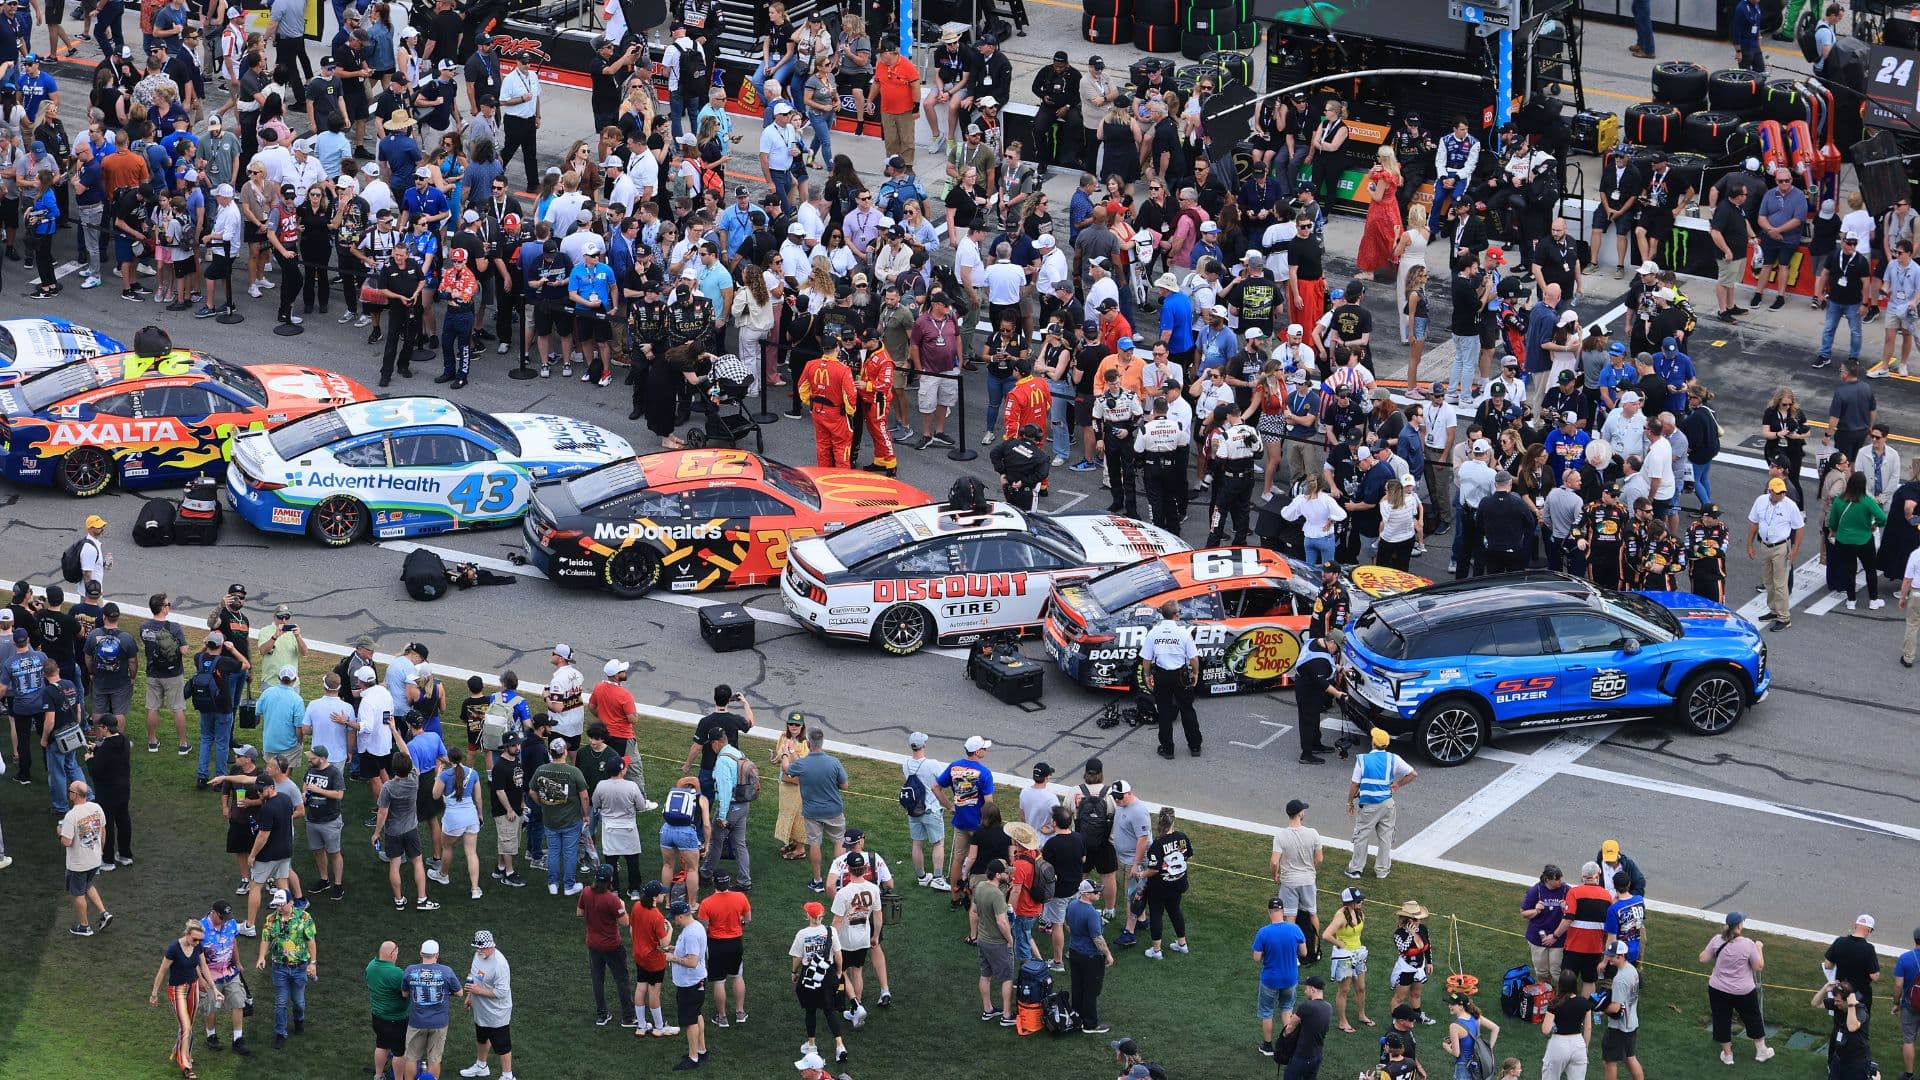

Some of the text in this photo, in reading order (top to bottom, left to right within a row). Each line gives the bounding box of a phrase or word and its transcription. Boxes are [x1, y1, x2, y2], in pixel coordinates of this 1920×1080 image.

[1485, 15, 1509, 25] musco
[1875, 56, 1914, 87] 24
[1352, 152, 1380, 161] LEGAC
[50, 421, 179, 446] AXALTA
[676, 451, 749, 479] 23
[447, 470, 520, 516] 43
[273, 508, 302, 518] FAMILY
[594, 522, 722, 541] McDonald's
[568, 557, 594, 567] leidos
[1192, 549, 1268, 582] 19
[565, 568, 596, 577] Columbia
[873, 572, 1028, 603] DISCOUNT
[947, 602, 994, 616] TIRE
[810, 612, 817, 621] 2
[1154, 638, 1181, 646] OFFICIAL
[1254, 631, 1284, 646] Bass
[1089, 648, 1138, 660] BOATS
[1254, 645, 1278, 659] Pro
[1254, 657, 1291, 673] Shops
[1202, 673, 1226, 681] COFFEE
[1212, 685, 1228, 693] Mobil
[1591, 679, 1627, 693] 500
[1496, 690, 1548, 704] BLAZER
[1520, 718, 1560, 727] OFFICIAL
[1163, 840, 1178, 854] DALE
[1164, 851, 1187, 876] 8
[851, 890, 873, 908] 40
